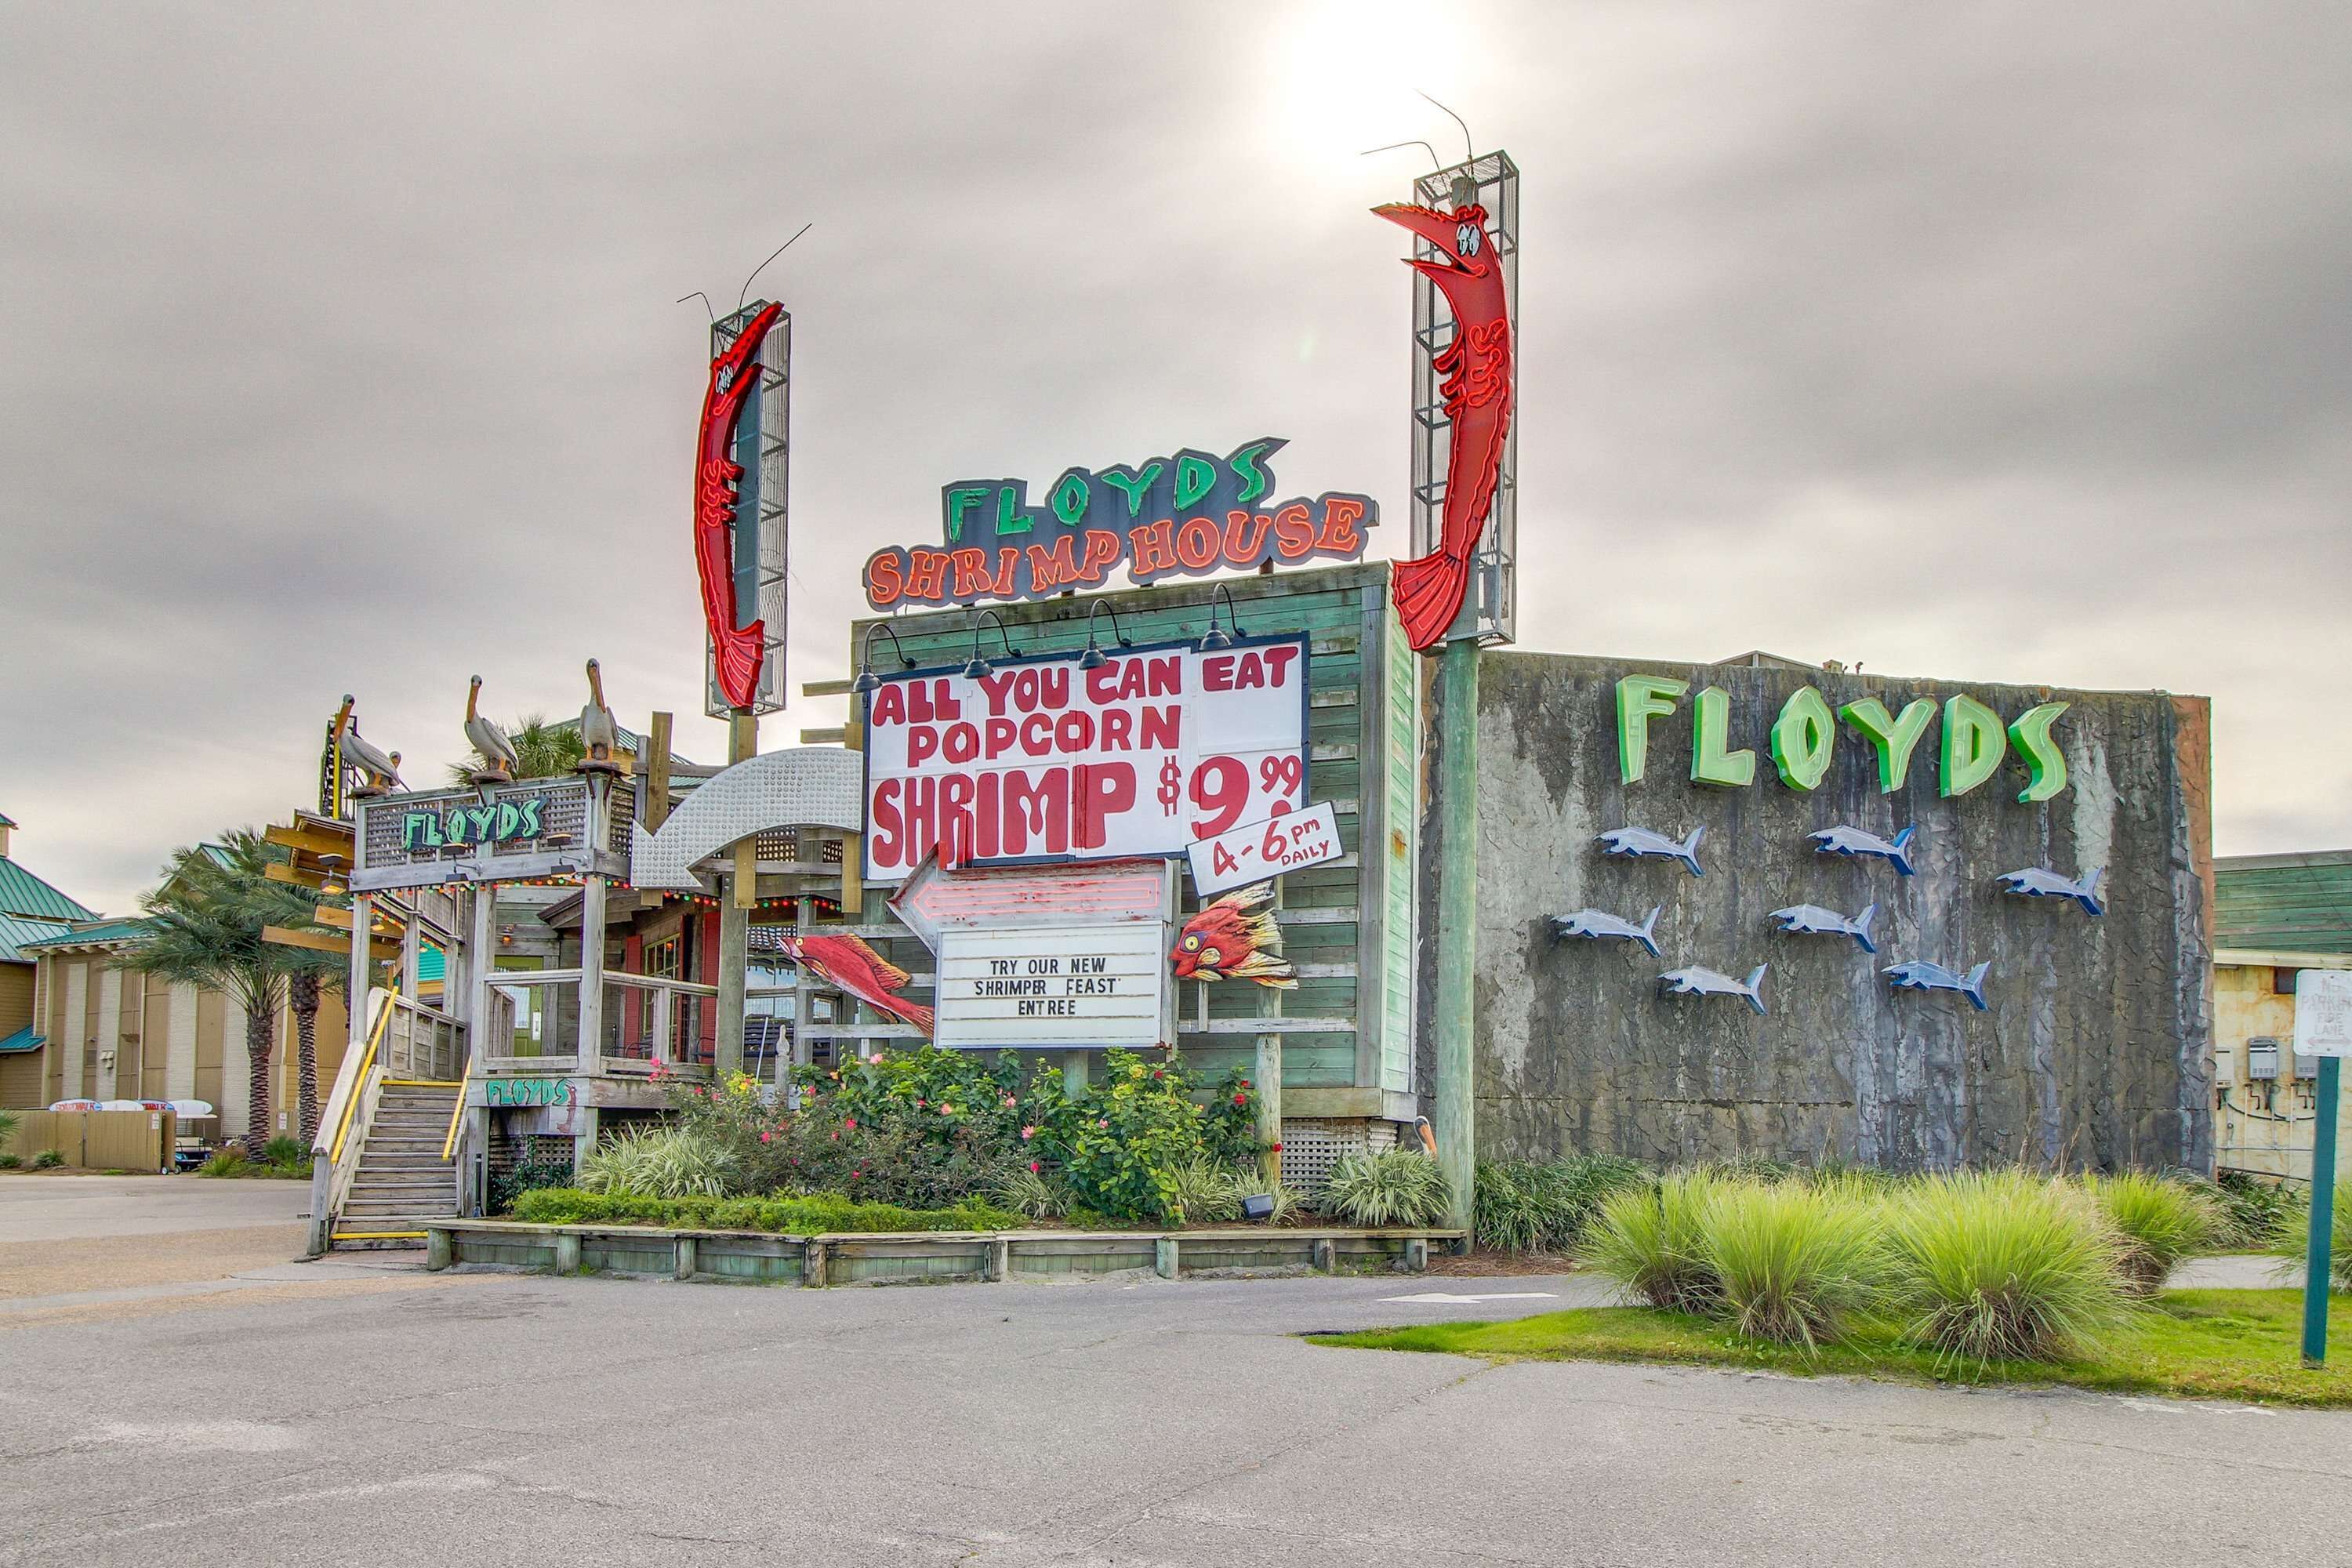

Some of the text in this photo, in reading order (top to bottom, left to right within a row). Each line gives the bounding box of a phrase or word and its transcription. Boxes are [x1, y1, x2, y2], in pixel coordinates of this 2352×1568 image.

[948, 443, 1270, 543] FLOYDS
[868, 498, 1364, 604] SHRIMP HOUSE
[873, 646, 1298, 727] ALL YOU CAN EAT
[907, 704, 1181, 768] POPCORN
[1615, 673, 2071, 804] FLOYDS
[401, 799, 541, 851] FLOYDS
[872, 762, 1135, 868] SHRIMP
[1281, 840, 1330, 866] DAILY
[990, 957, 1106, 975] TRY OUR NEW
[1018, 1000, 1076, 1015] ENTREE
[486, 1078, 569, 1105] FLOYDS
